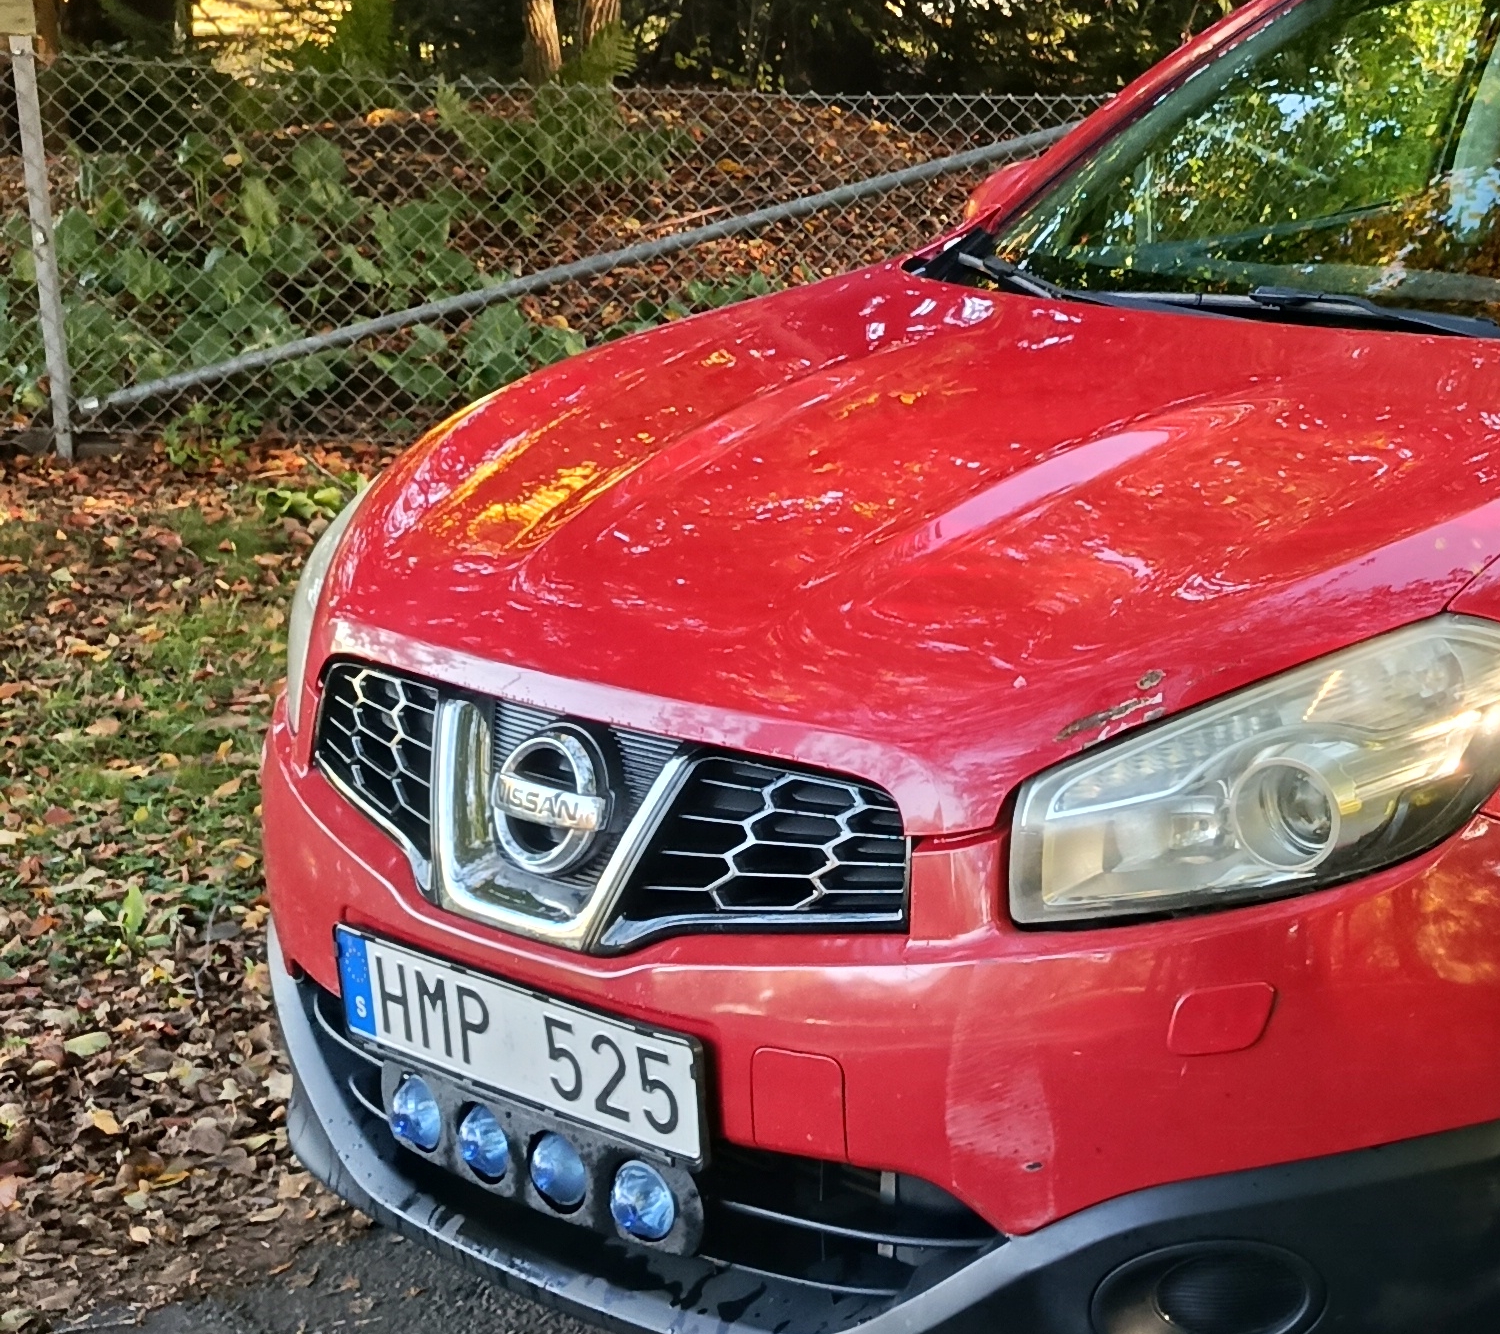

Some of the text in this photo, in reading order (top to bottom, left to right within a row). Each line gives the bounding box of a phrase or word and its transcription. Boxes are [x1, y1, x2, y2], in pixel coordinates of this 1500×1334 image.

[355, 995, 367, 1018] S
[375, 954, 679, 1135] HMP 525
